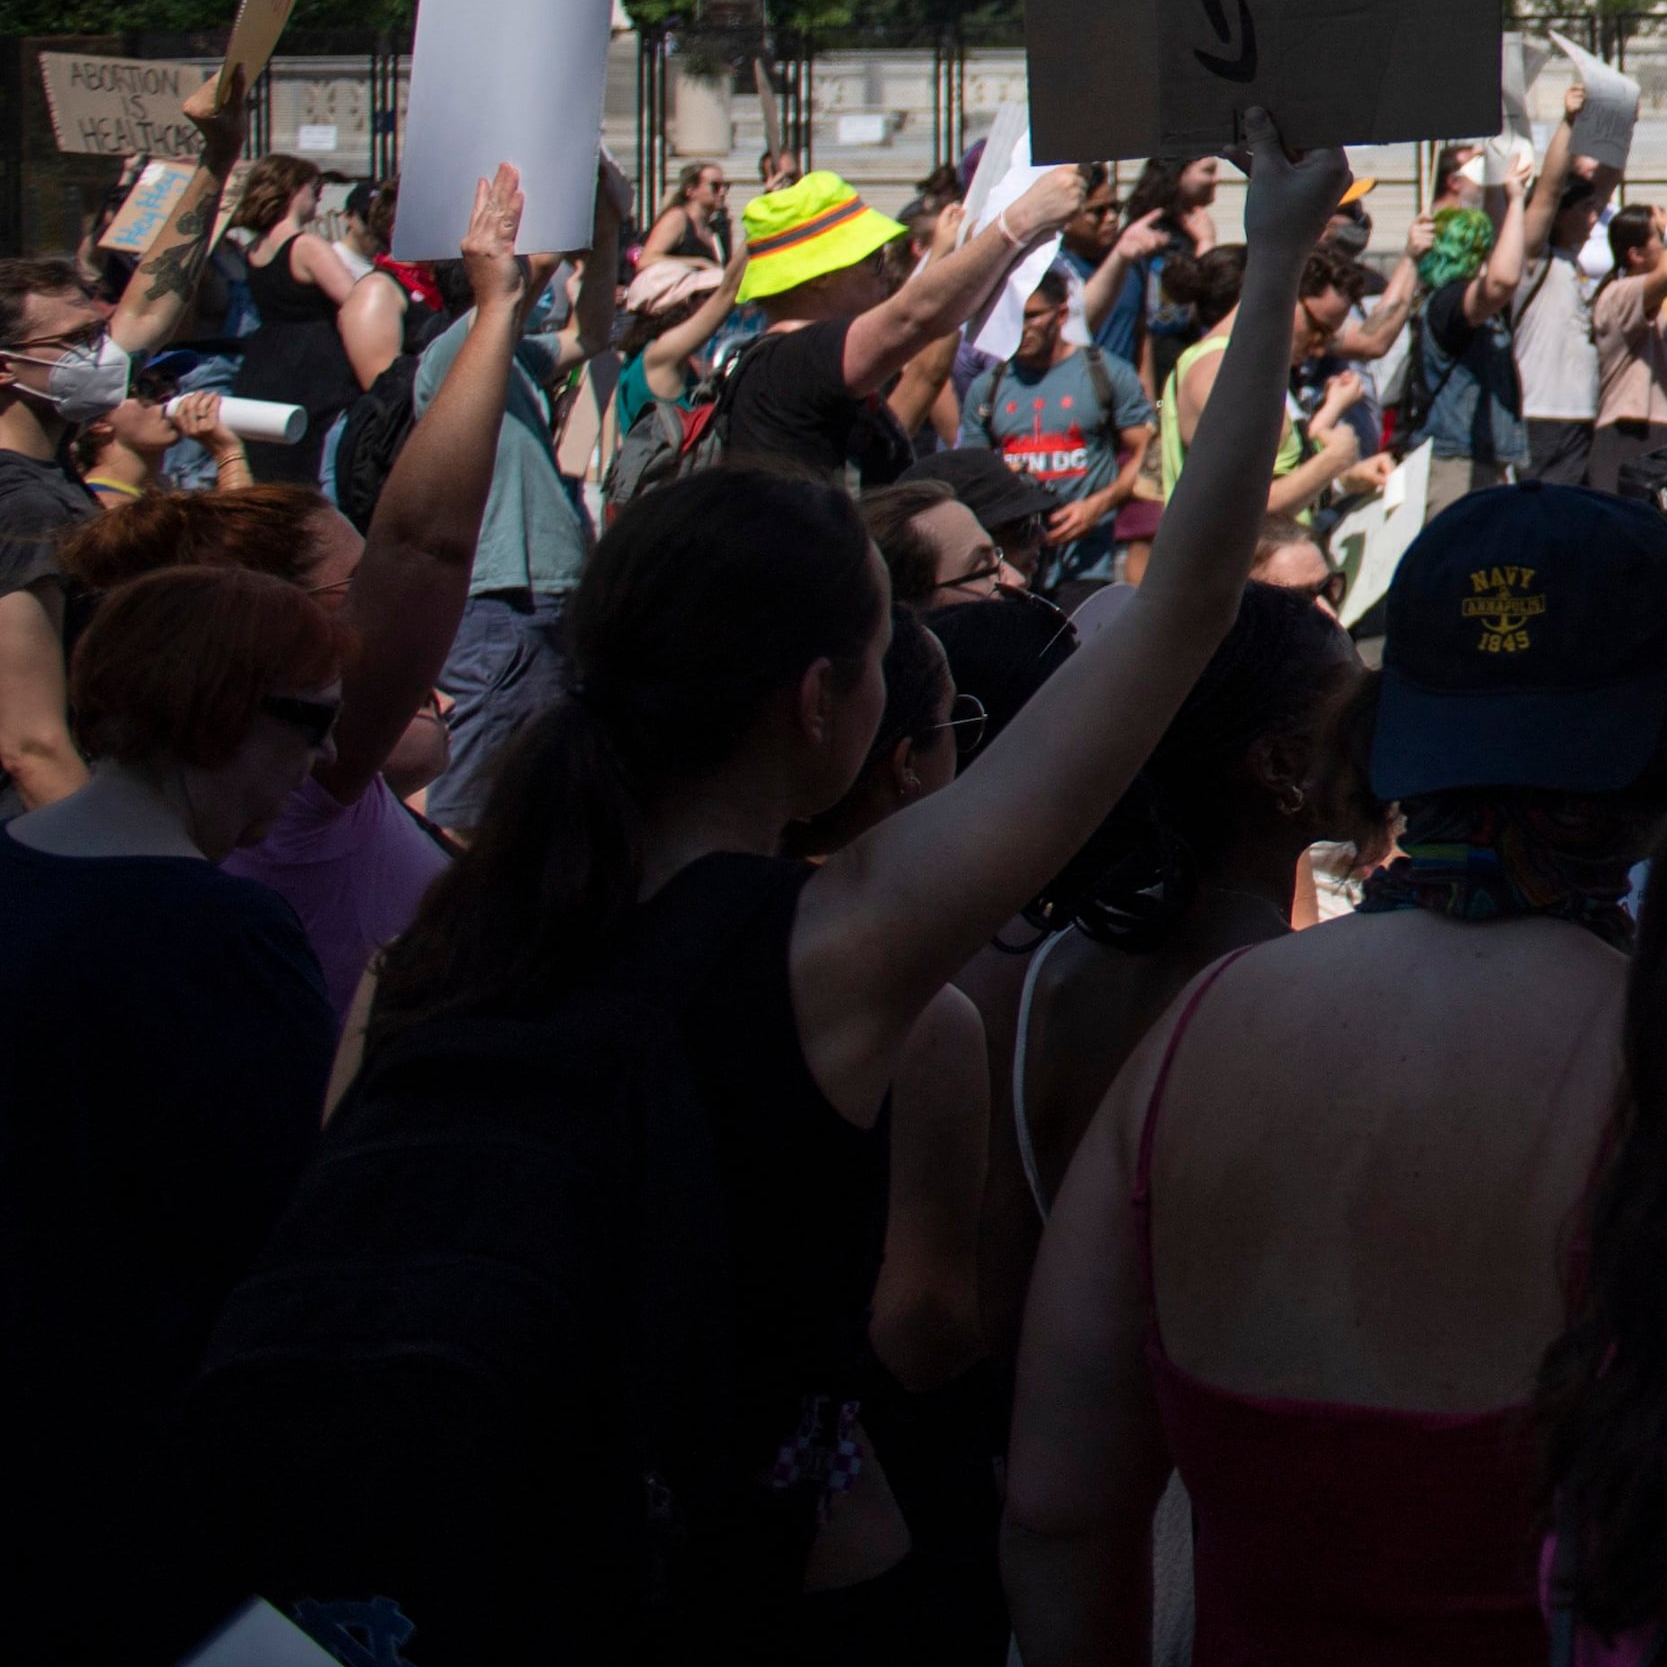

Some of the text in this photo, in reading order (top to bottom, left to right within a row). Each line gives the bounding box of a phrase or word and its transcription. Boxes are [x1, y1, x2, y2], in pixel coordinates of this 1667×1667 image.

[71, 61, 180, 96] ABORTION
[123, 94, 147, 120] IS
[1052, 447, 1089, 472] DC
[1469, 565, 1537, 593] NAVY
[1477, 629, 1530, 653] 1845
